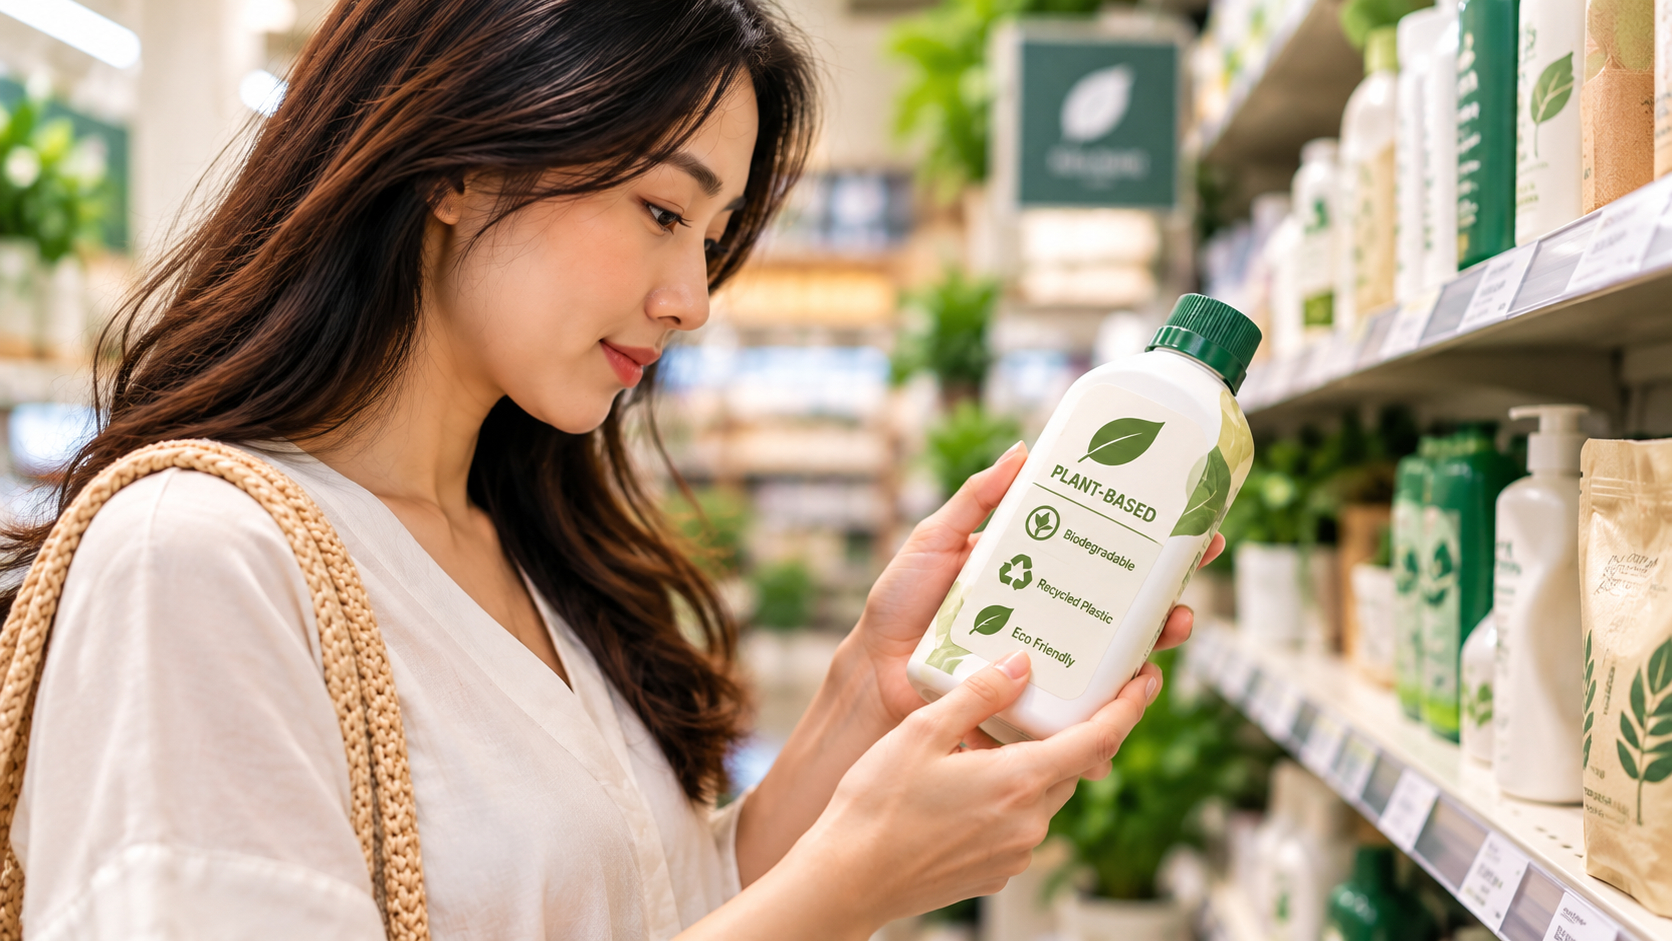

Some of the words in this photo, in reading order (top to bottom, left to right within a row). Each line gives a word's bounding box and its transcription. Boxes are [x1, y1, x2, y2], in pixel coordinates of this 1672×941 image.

[1050, 464, 1157, 523] PLANT-BASED
[1063, 528, 1136, 572] Biodegradable
[1036, 578, 1082, 608] Recycled
[1079, 600, 1114, 625] Plastic
[1011, 626, 1032, 645] Eco
[1032, 637, 1076, 669] Friendly
